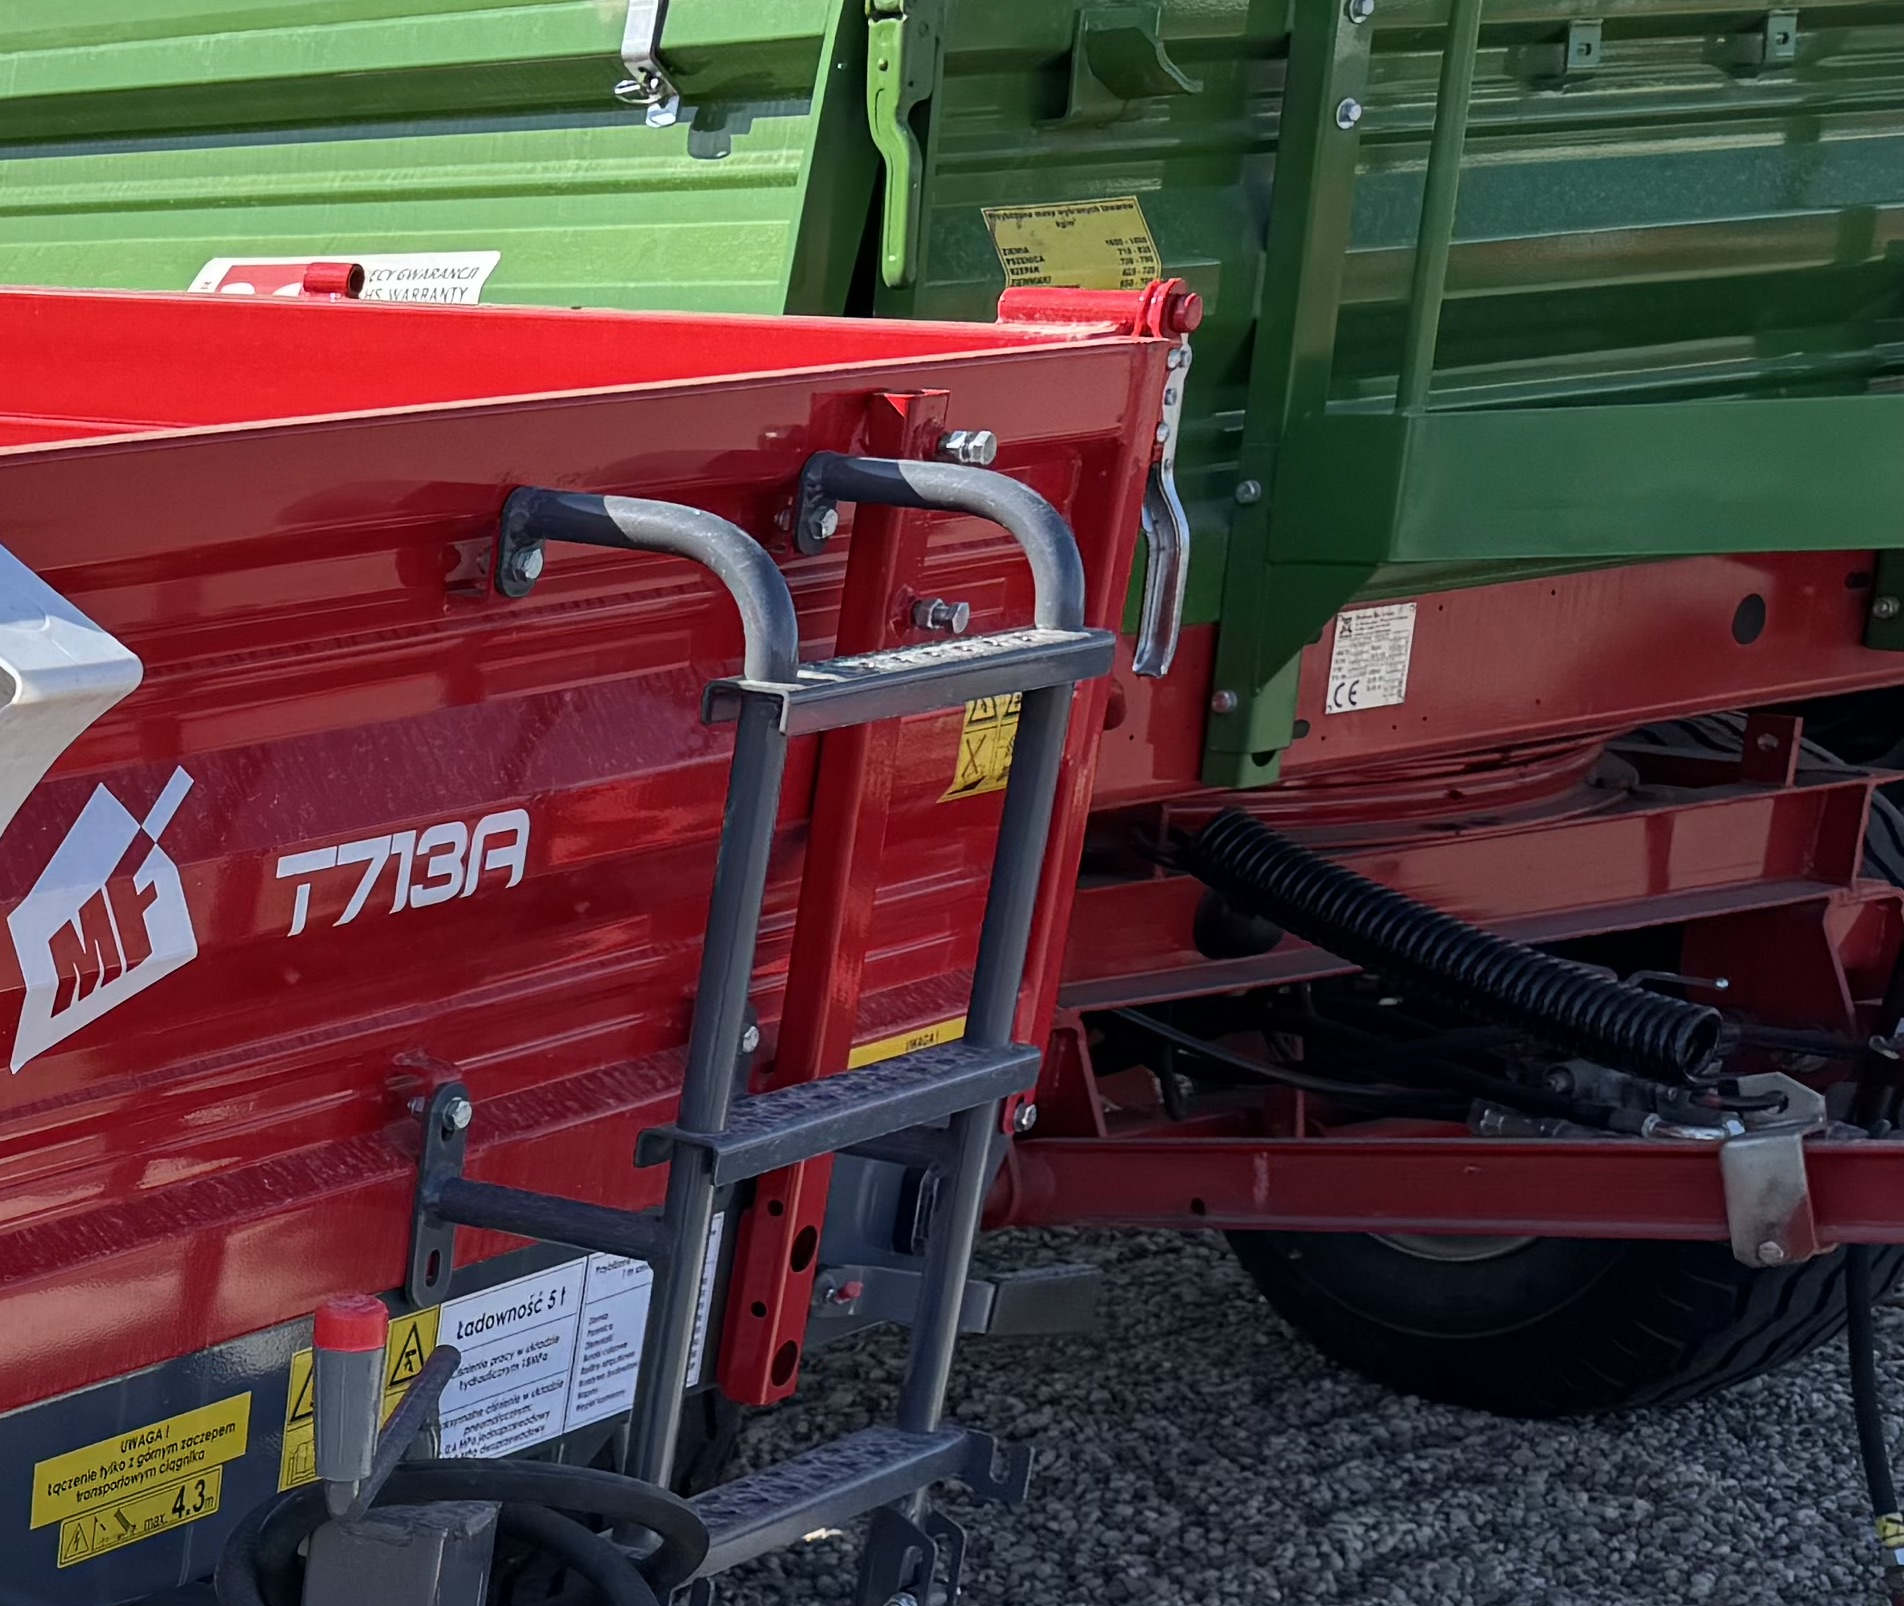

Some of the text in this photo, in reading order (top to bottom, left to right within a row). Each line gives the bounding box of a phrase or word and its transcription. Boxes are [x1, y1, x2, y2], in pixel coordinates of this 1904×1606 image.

[389, 287, 470, 303] WARRANTY
[276, 808, 530, 937] T713A
[457, 1290, 543, 1340] Ładowność
[548, 1288, 558, 1311] 5
[48, 1422, 236, 1496] Łączenie tylko z górnym zaczepem
[121, 1431, 163, 1453] UWAGA
[76, 1449, 205, 1503] transportowym ciągnika
[143, 1512, 169, 1532] max.
